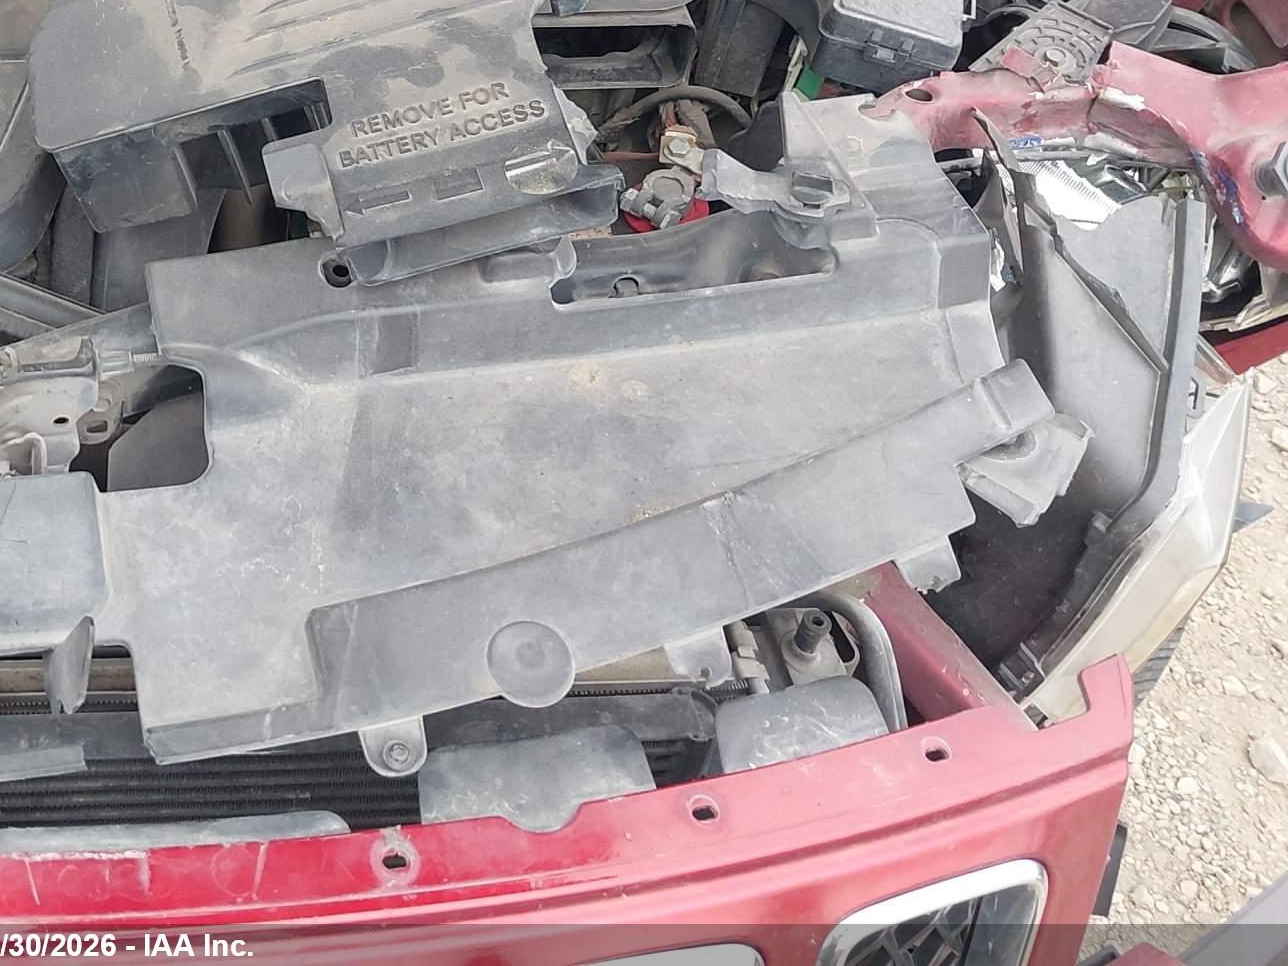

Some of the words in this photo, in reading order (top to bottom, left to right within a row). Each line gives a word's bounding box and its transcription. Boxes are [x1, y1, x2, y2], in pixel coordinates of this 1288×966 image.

[338, 128, 441, 169] BATTERY
[450, 99, 547, 141] ACCESS
[350, 97, 455, 138] REMOVE
[458, 81, 511, 111] FOR
